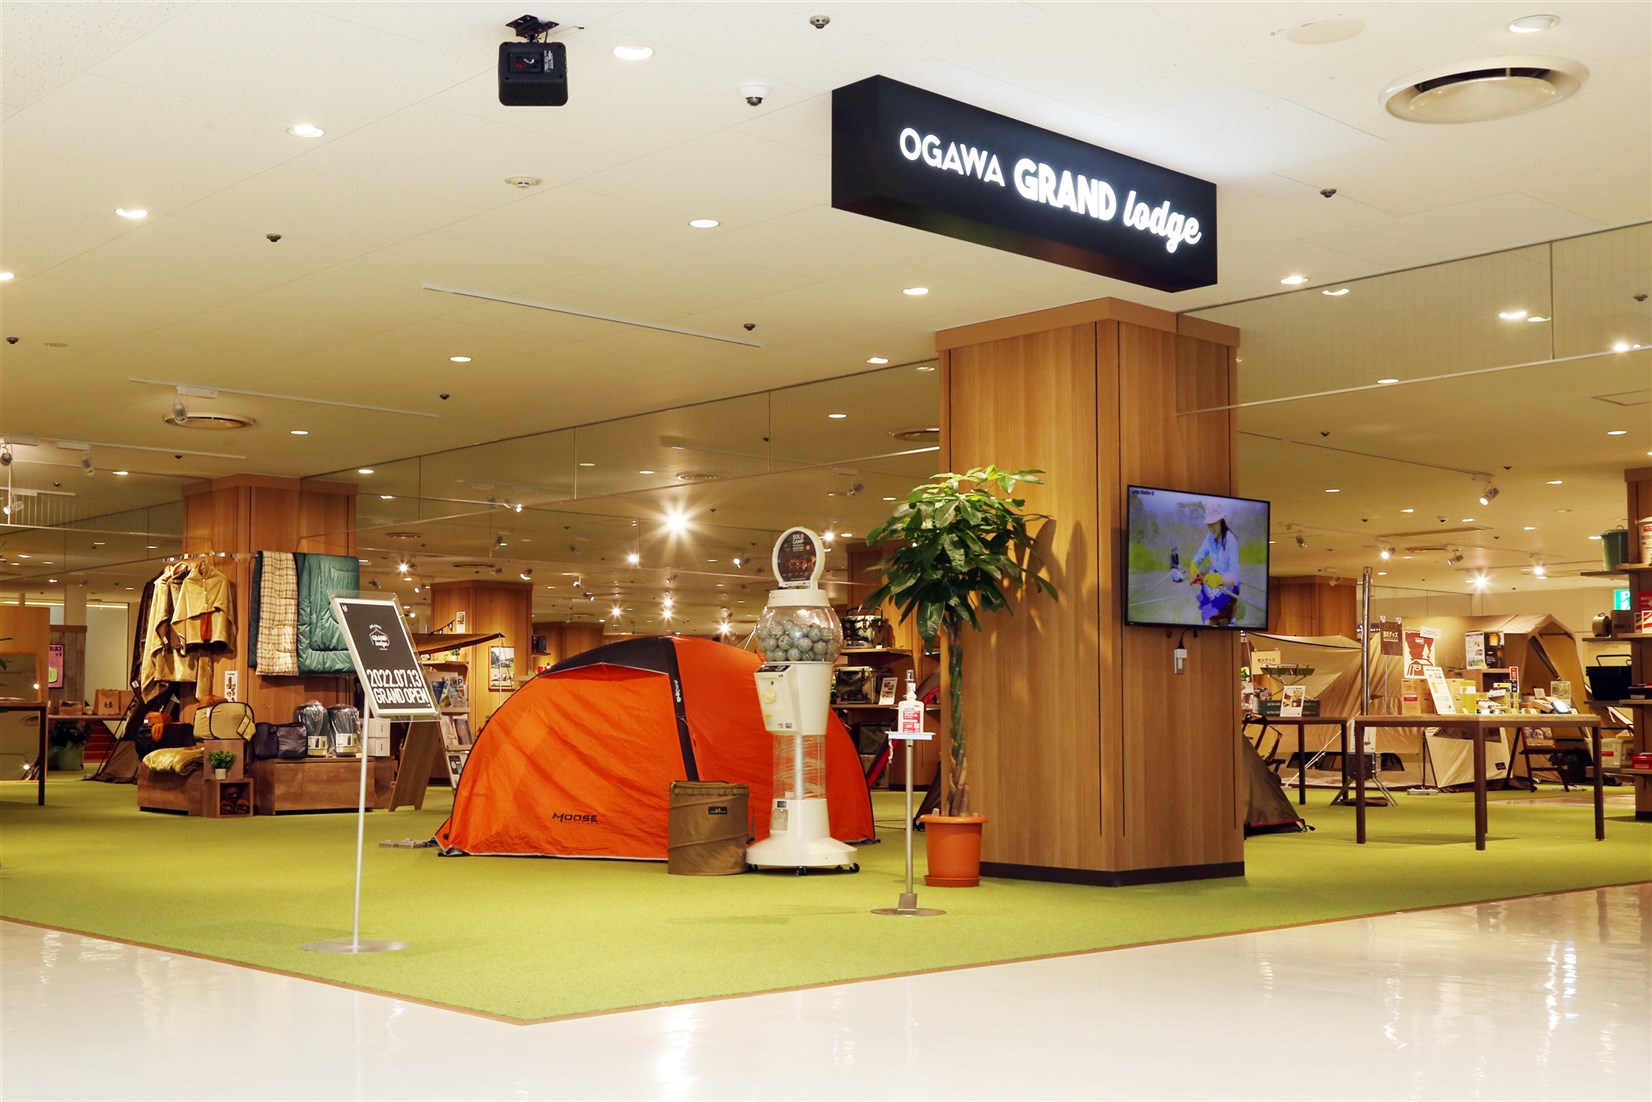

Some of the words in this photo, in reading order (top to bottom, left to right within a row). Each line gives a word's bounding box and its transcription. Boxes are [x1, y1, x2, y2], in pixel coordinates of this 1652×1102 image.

[899, 127, 1005, 187] OGAWA
[1013, 158, 1117, 222] GRAND
[1123, 189, 1203, 254] lodge
[366, 669, 422, 688] 2022.07.13
[373, 687, 406, 704] GRAND
[403, 687, 430, 704] OPEN
[552, 812, 598, 823] MOOSE
